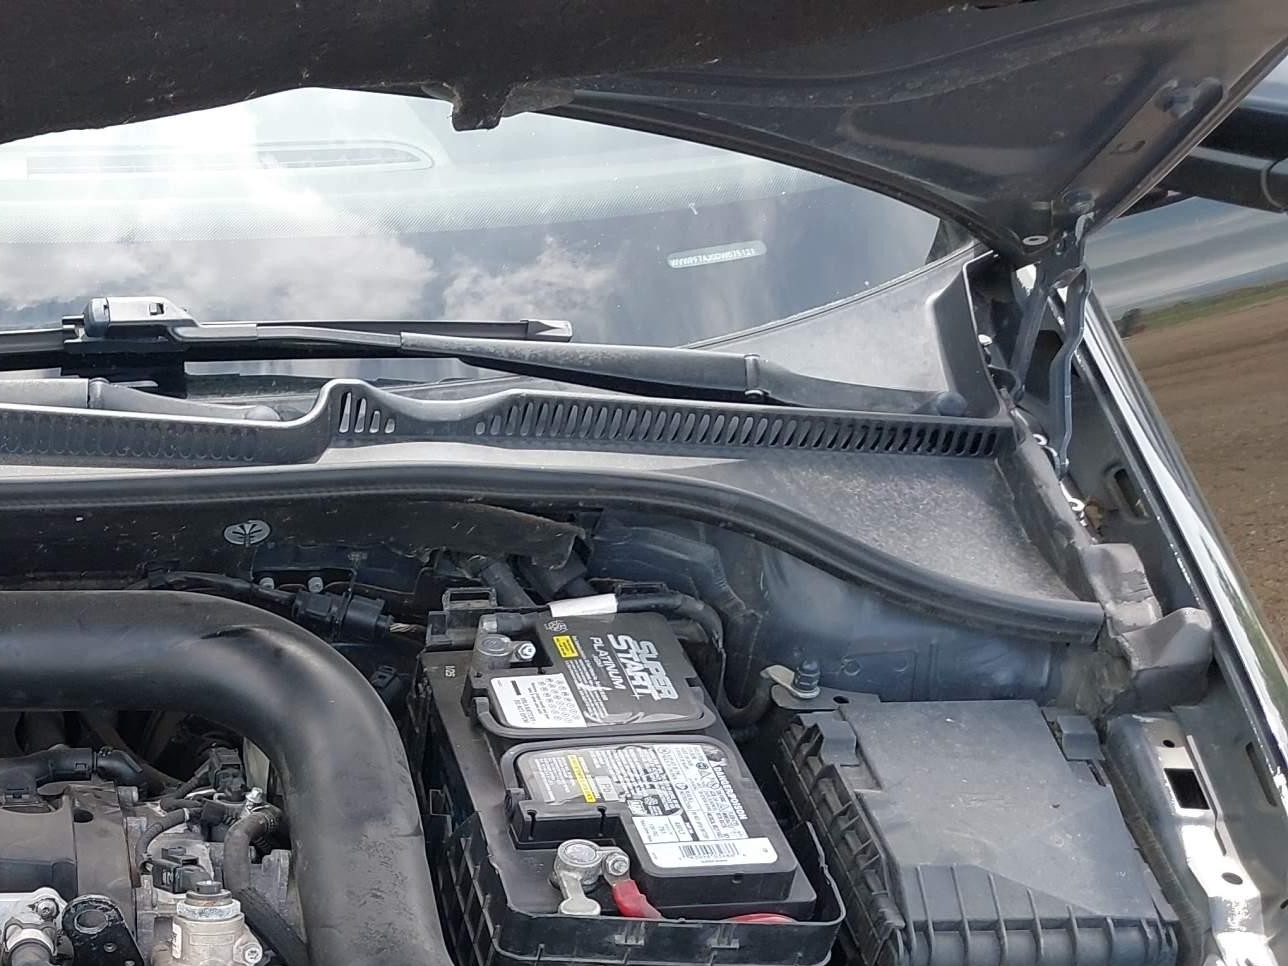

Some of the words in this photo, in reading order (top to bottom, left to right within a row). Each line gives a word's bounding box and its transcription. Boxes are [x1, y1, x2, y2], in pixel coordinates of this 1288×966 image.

[589, 637, 627, 690] PLATINUM
[608, 634, 662, 701] START
[638, 641, 679, 700] SUPER
